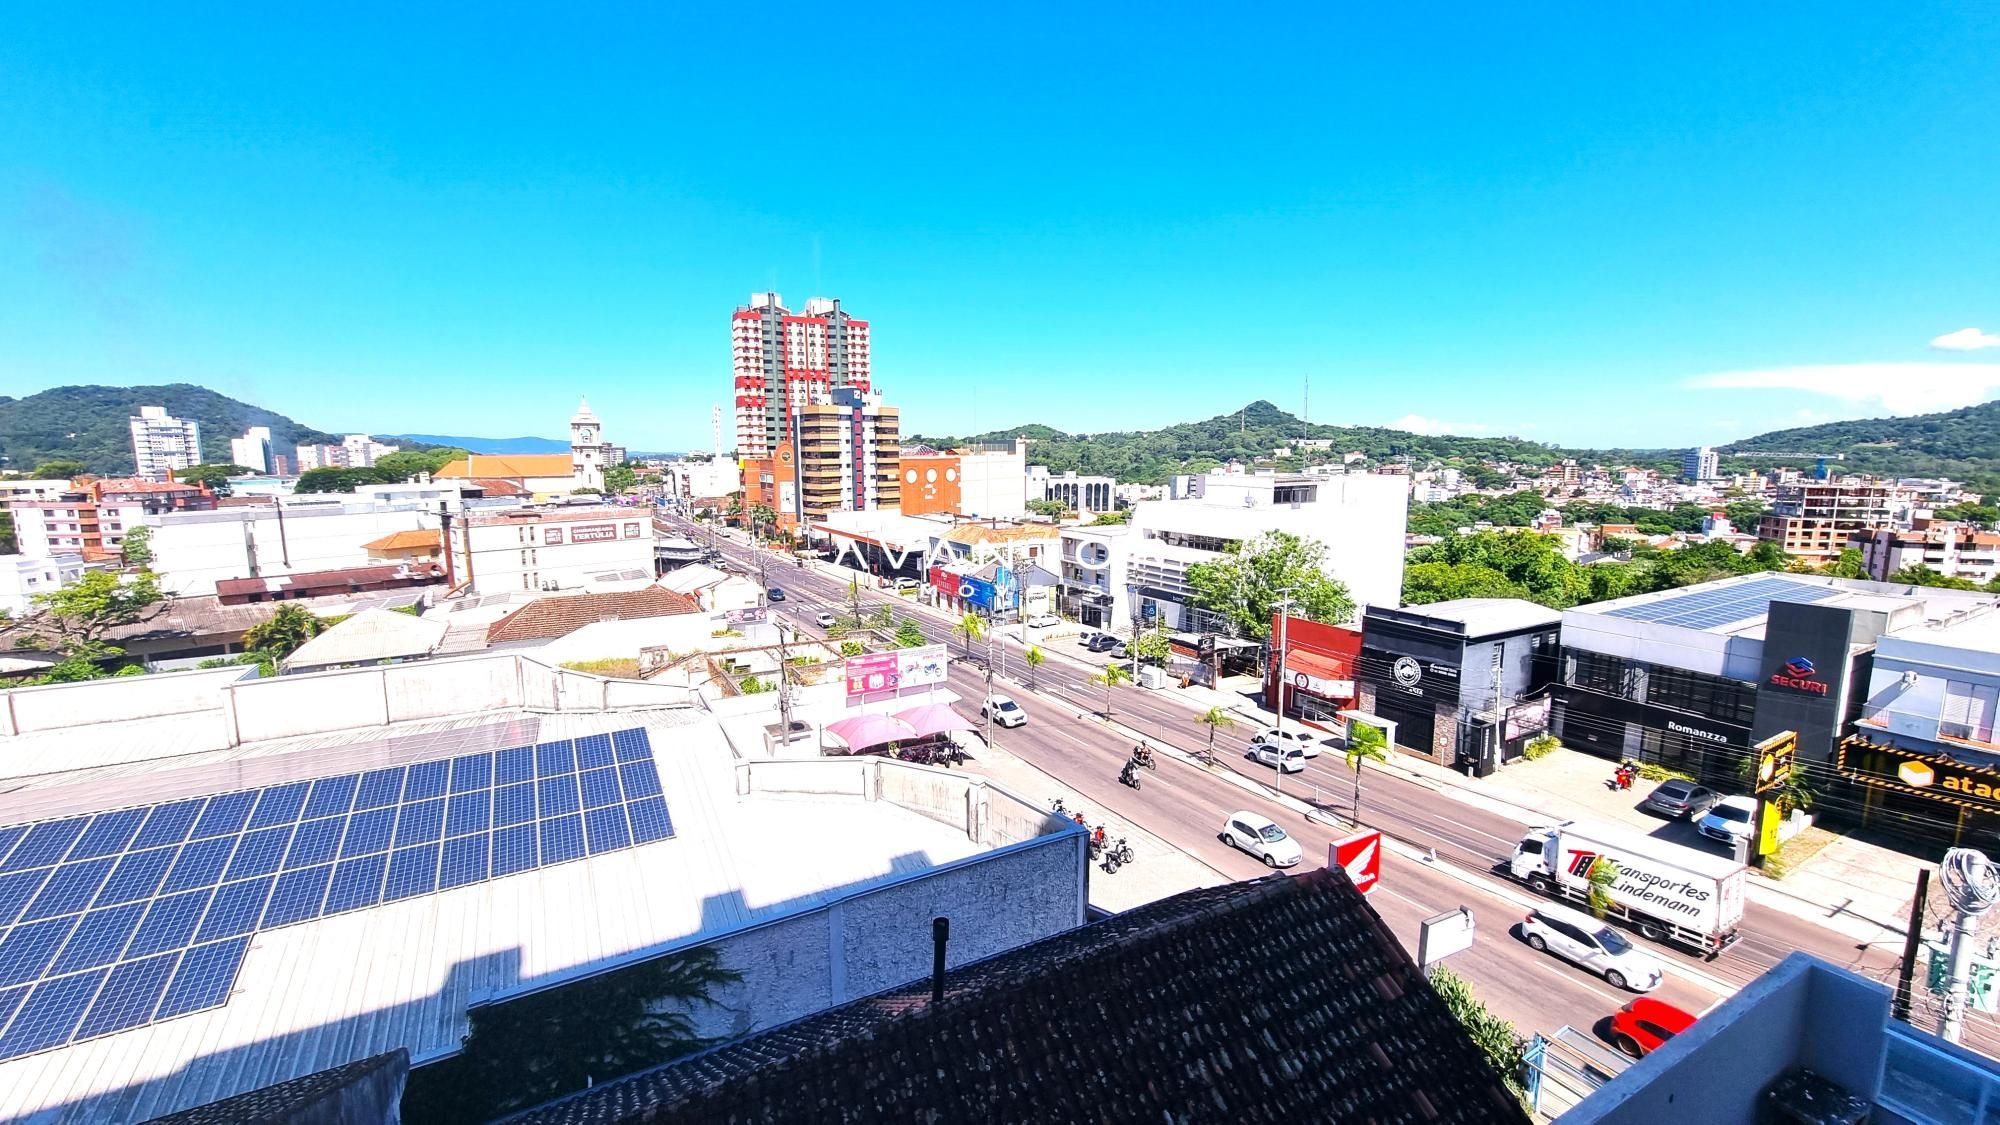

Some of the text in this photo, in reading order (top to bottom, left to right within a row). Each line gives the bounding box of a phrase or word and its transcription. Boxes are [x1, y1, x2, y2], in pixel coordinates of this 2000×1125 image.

[1770, 675, 1828, 696] SECURI
[1667, 720, 1728, 744] Romanzza
[1606, 857, 1711, 902] Transportes
[1607, 876, 1701, 917] Lindemann
